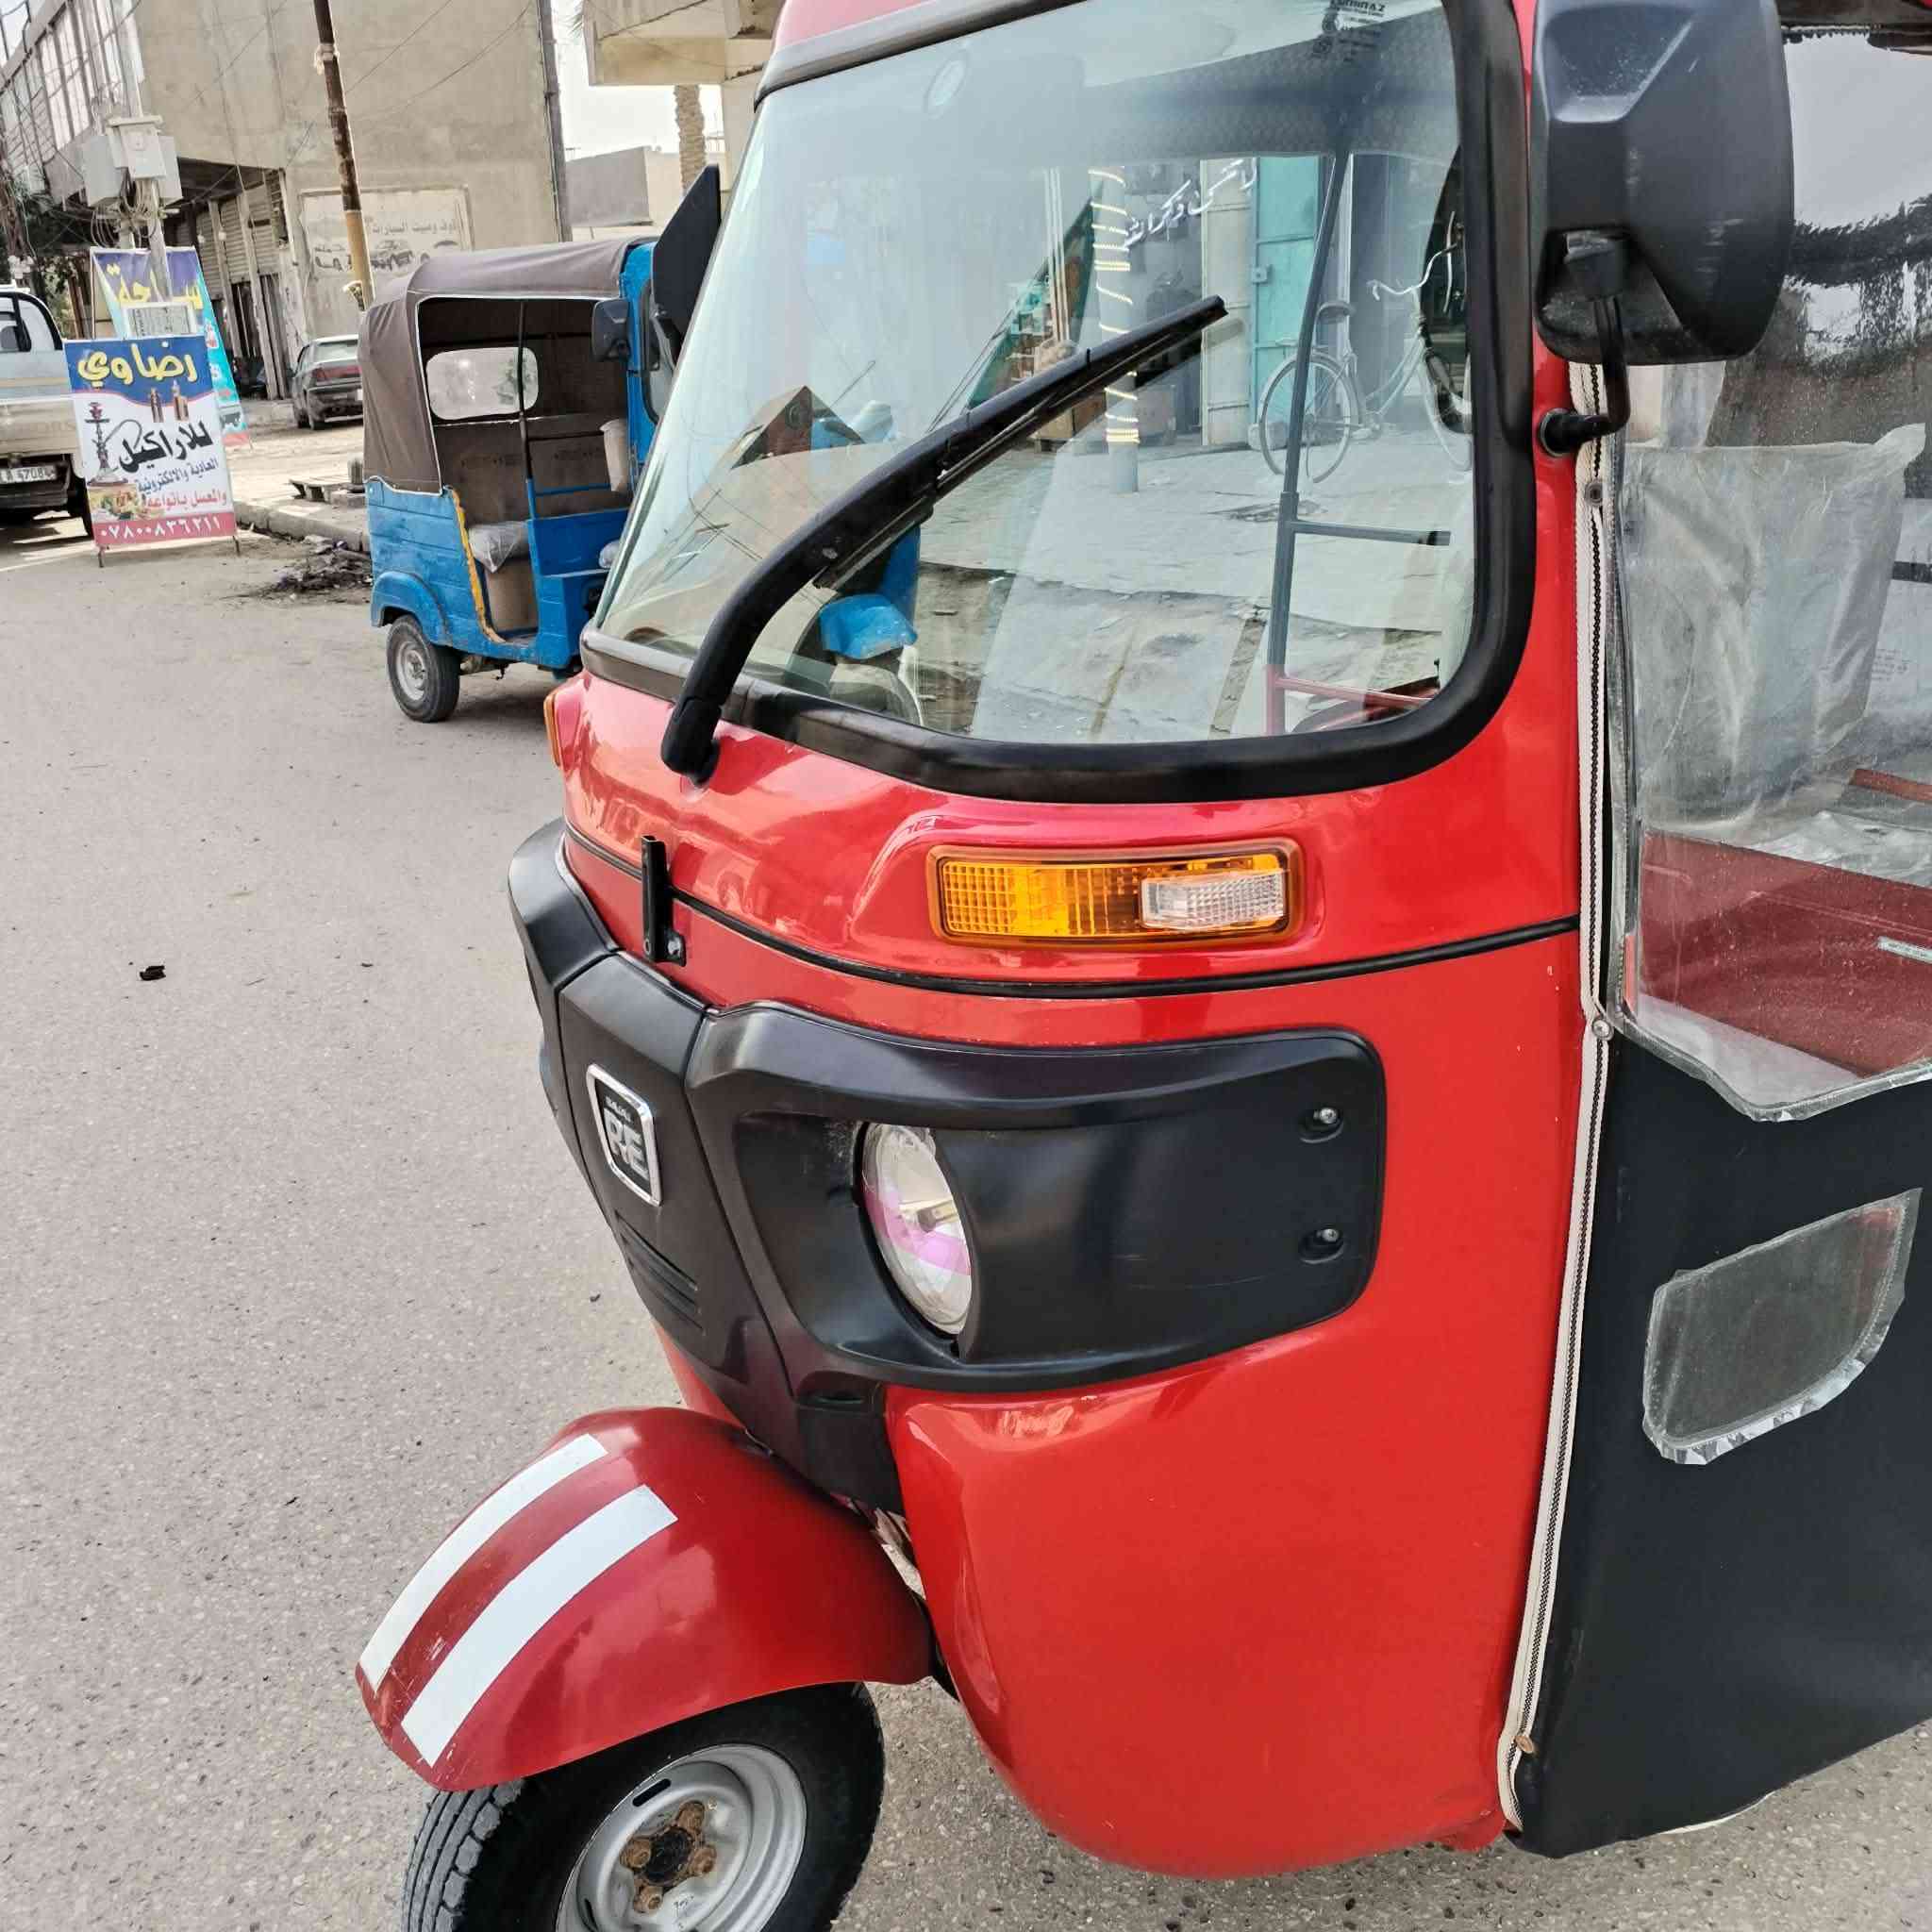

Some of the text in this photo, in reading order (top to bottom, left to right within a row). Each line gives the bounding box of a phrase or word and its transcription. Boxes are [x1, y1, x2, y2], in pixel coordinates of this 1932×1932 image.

[77, 341, 197, 388] رضاوي
[119, 421, 213, 474] للاراكيل
[604, 1107, 649, 1181] RE
